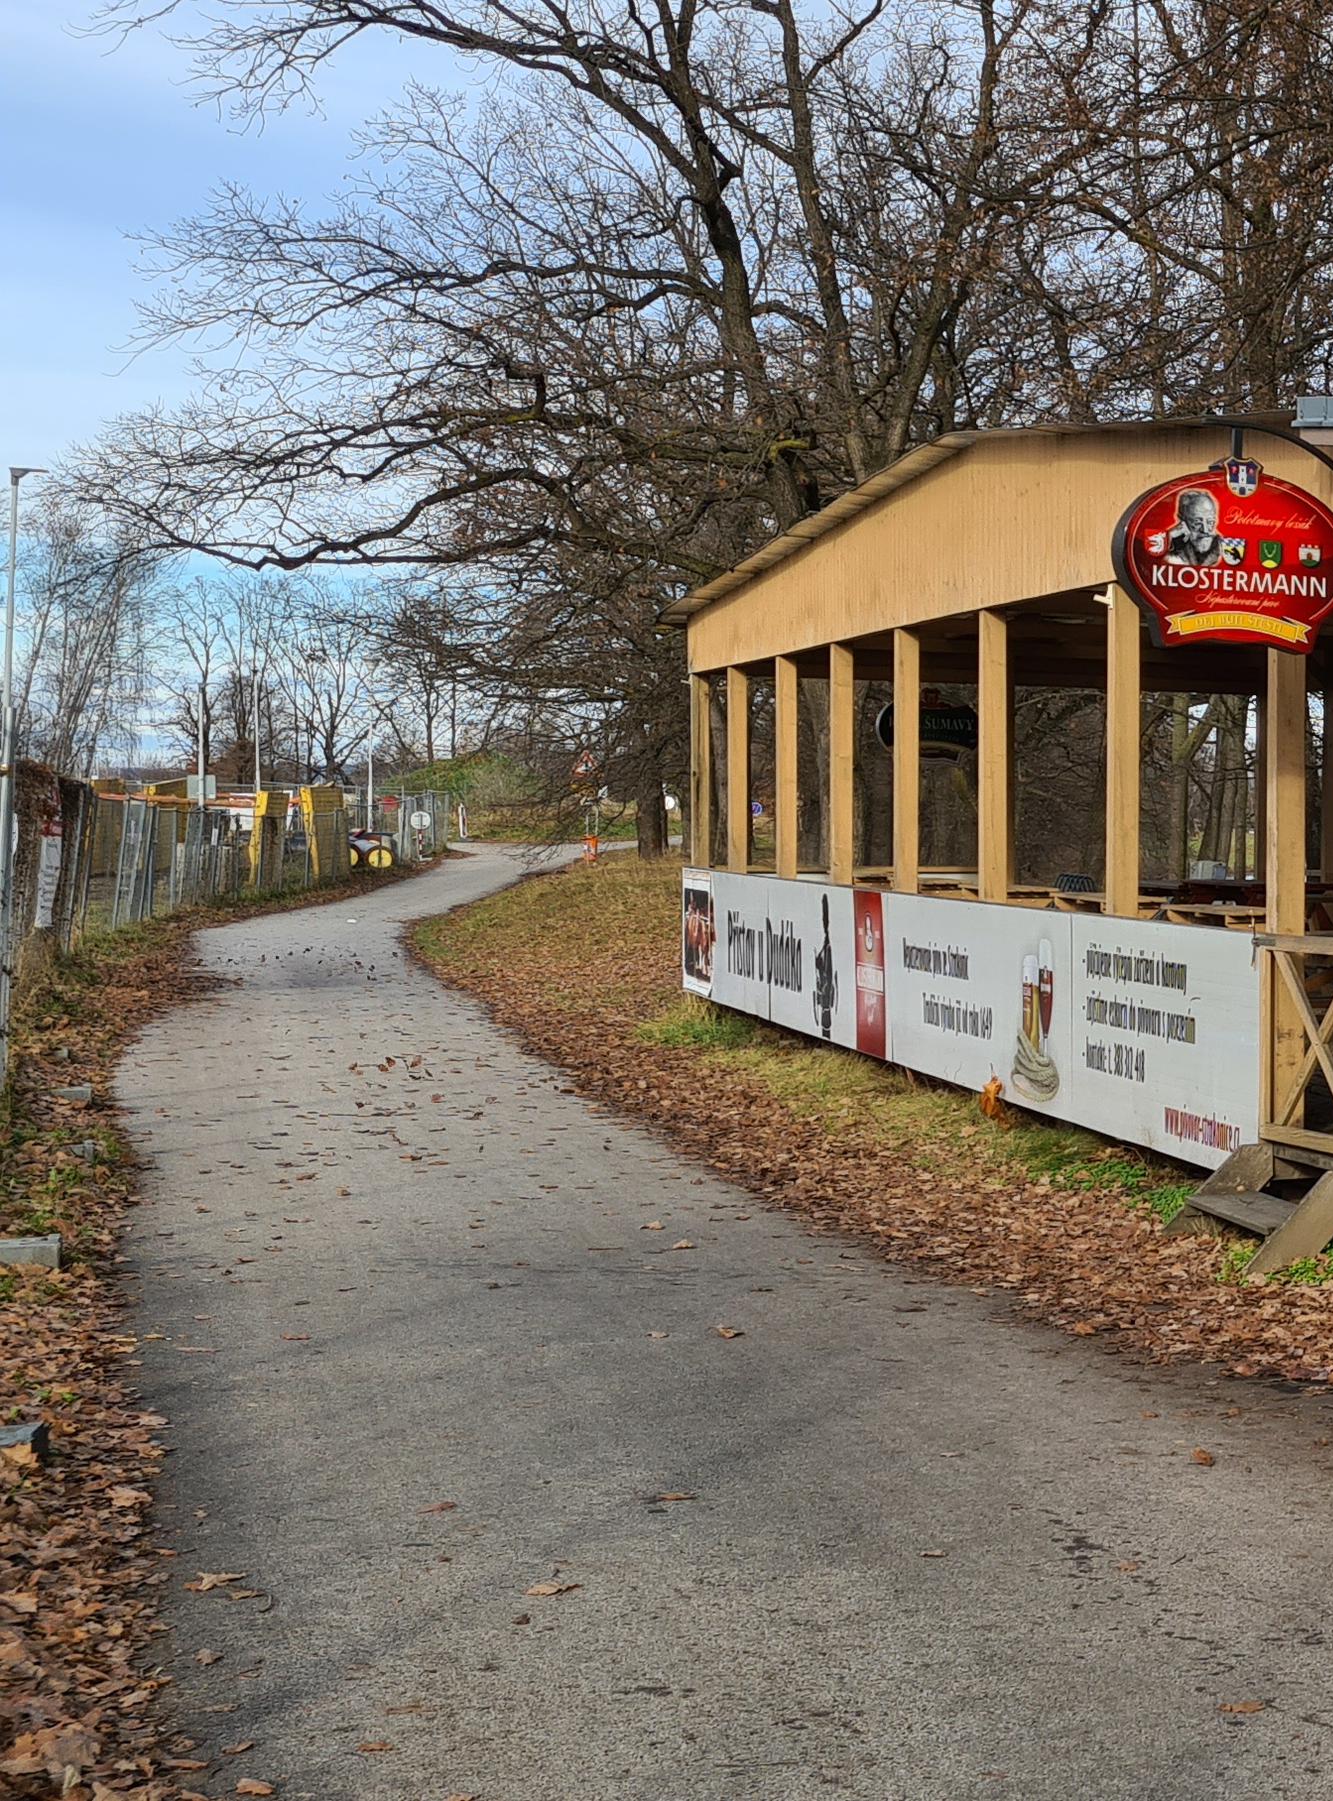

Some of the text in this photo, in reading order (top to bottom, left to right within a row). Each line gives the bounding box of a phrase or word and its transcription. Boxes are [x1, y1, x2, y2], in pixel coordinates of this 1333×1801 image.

[1152, 565, 1326, 598] KLOSTERMANN
[727, 909, 755, 980] Přístav
[765, 917, 802, 993] Dudáka
[1114, 1043, 1123, 1077] 383
[1124, 1045, 1133, 1080] 312
[1135, 1047, 1145, 1083] 418
